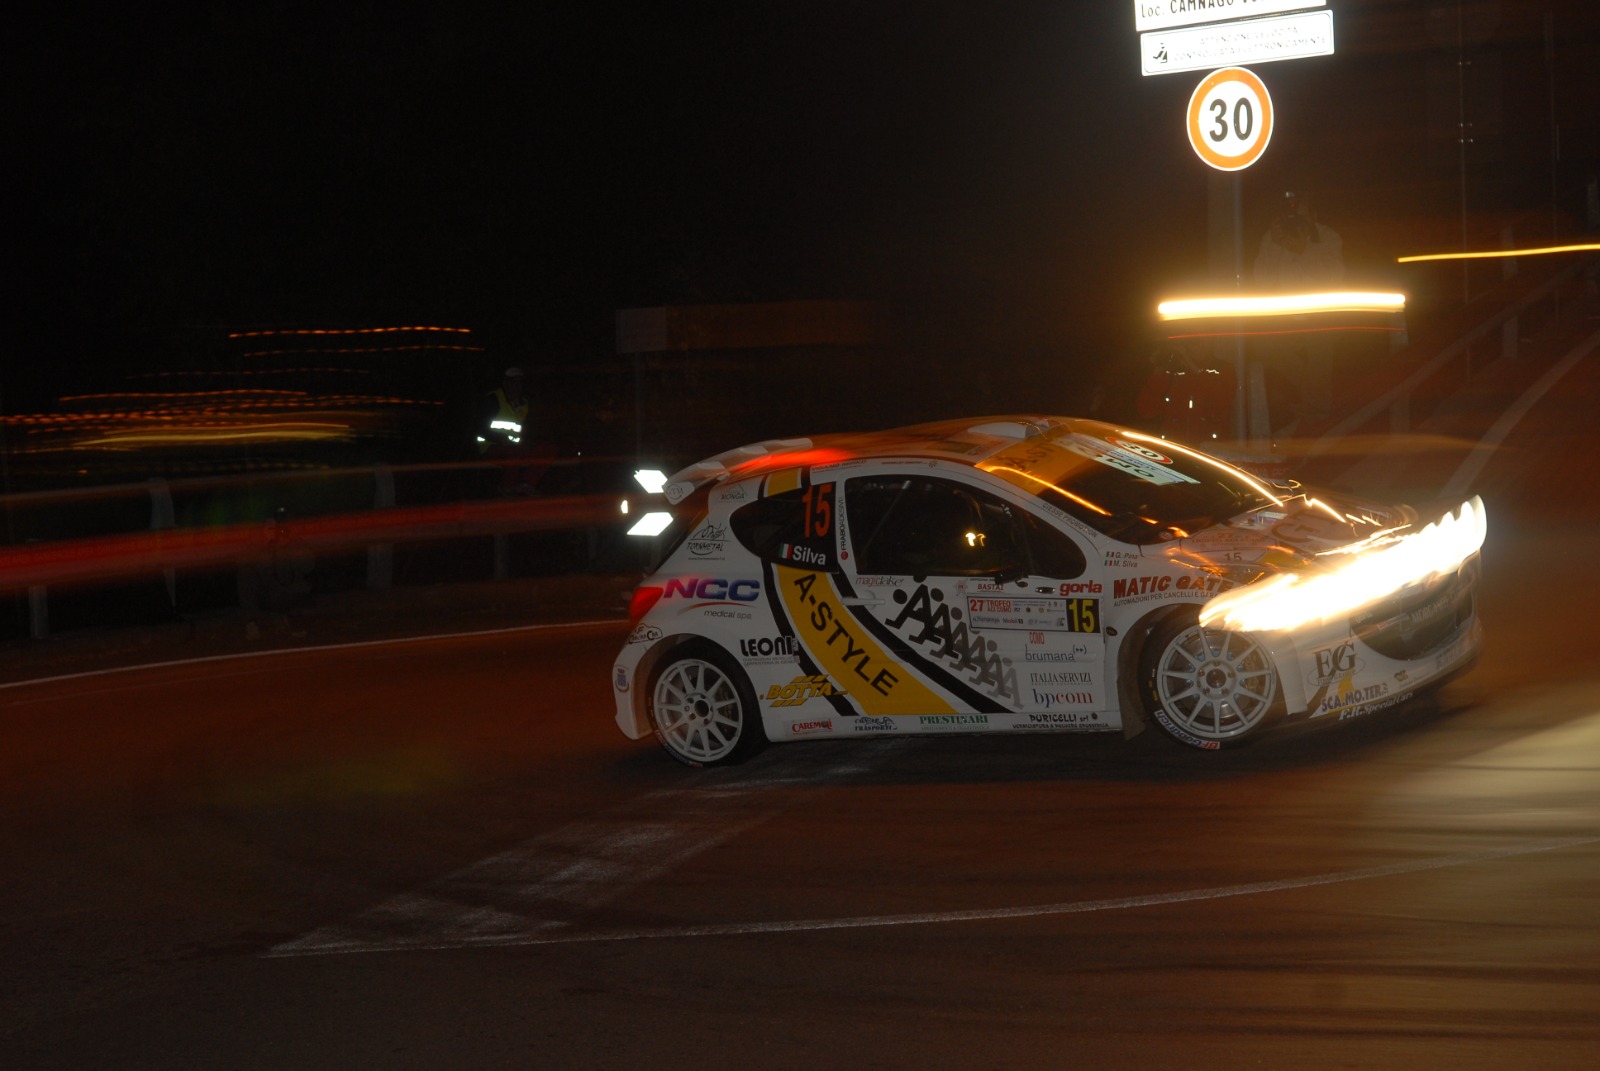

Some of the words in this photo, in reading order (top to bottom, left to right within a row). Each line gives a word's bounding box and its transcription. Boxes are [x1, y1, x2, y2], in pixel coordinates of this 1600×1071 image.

[1209, 97, 1253, 142] 30
[801, 483, 833, 539] 15
[792, 545, 827, 566] Silva
[1123, 560, 1138, 568] Silva
[1224, 552, 1242, 562] 15
[1060, 580, 1103, 596] gorla
[1114, 575, 1172, 599] MATIC
[969, 599, 985, 612] 27
[987, 599, 1011, 608] TROFEO
[1113, 595, 1150, 608] AUTOMAZIONI
[1151, 592, 1163, 600] PER
[1163, 591, 1193, 599] CANCELLI
[704, 609, 736, 619] medical
[737, 612, 752, 620] spa
[1068, 598, 1097, 634] 15
[794, 573, 899, 697] A-STYLE
[1029, 631, 1045, 645] COMO
[740, 636, 793, 657] LEONI
[1024, 643, 1076, 662] brumana
[1030, 672, 1058, 683] ITALIA
[1058, 672, 1092, 682] SERVIZI
[766, 681, 834, 700] BOTTA
[1033, 688, 1093, 708] bpcom
